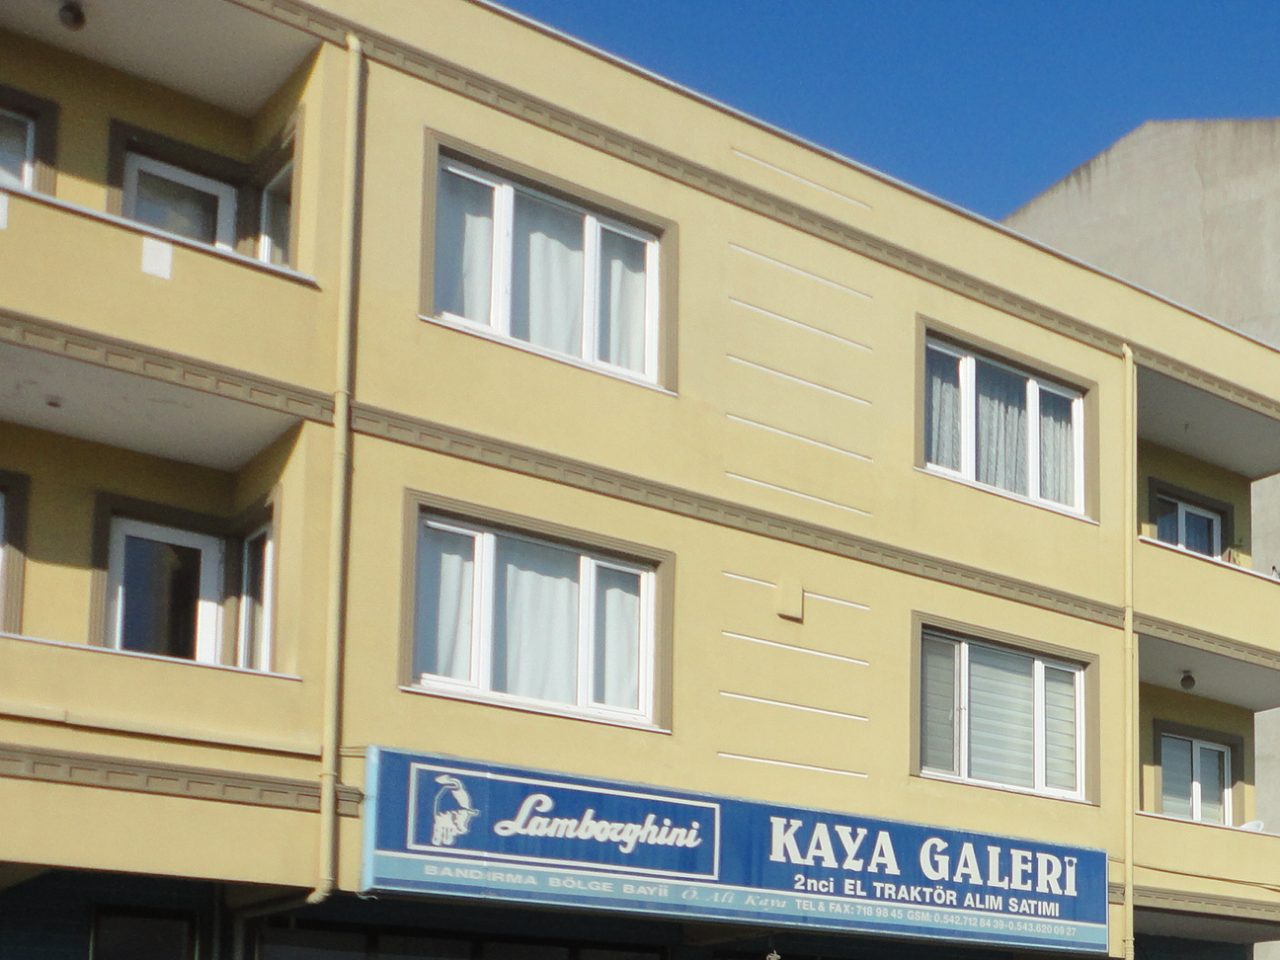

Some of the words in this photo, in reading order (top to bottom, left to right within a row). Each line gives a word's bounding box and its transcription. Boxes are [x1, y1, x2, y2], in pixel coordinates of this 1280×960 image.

[494, 793, 702, 854] Lamborghini
[423, 864, 538, 886] BANDIRMA
[547, 876, 615, 893] BÖLGE
[769, 816, 900, 875] KAYA
[919, 837, 1078, 897] GALERİ
[794, 874, 834, 894] 2nci
[844, 880, 867, 896] EL
[873, 882, 957, 906] TRAKTÖR
[963, 893, 1003, 911] ALIM
[1008, 898, 1060, 918] SATIMI
[795, 899, 816, 911] TEL
[829, 904, 854, 915] FAX:
[906, 910, 932, 922] GSM:
